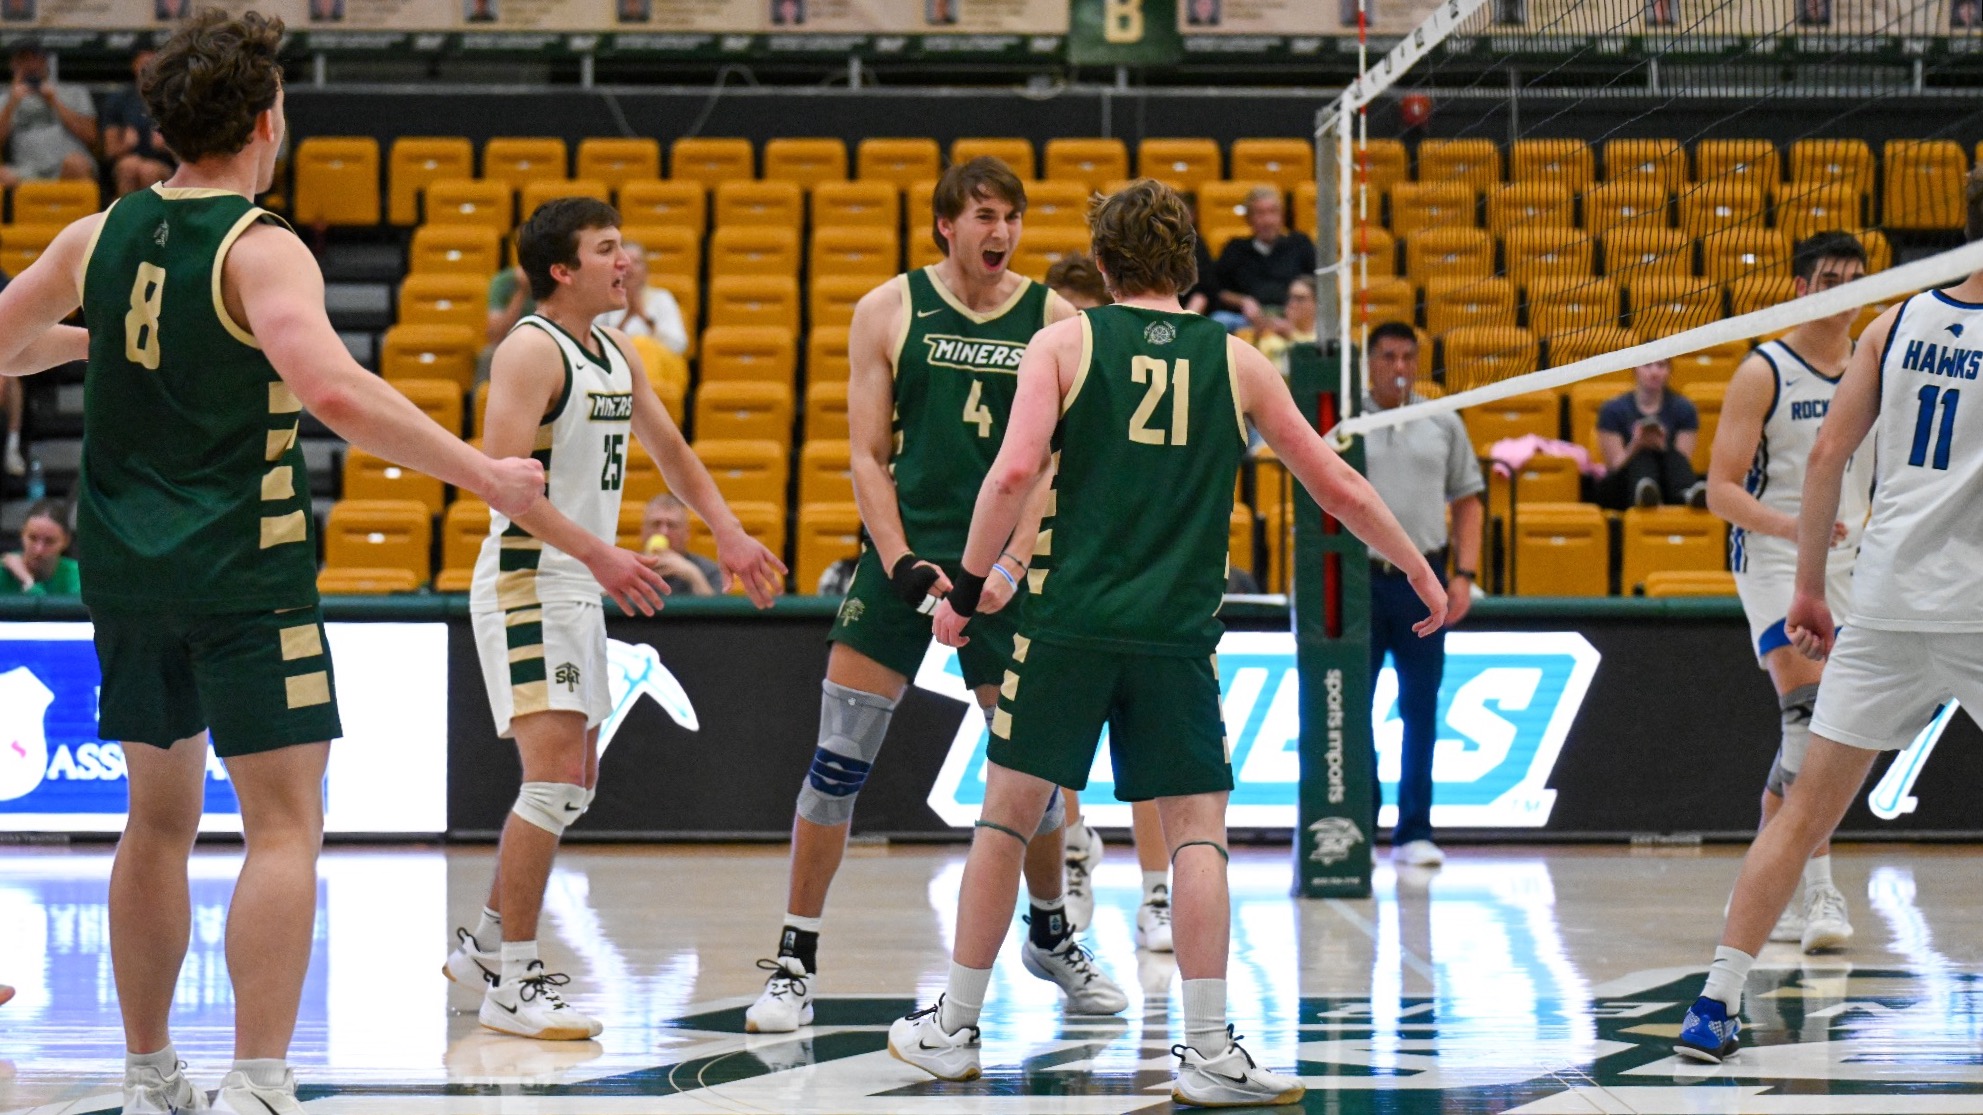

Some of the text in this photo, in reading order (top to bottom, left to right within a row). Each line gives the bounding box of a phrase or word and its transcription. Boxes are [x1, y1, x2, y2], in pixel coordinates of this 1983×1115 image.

[125, 261, 166, 370] 8
[935, 338, 1026, 367] MINERS
[1902, 340, 1983, 381] HAWKS
[963, 379, 993, 438] 4
[1129, 355, 1190, 446] 21
[1908, 384, 1960, 471] 11
[601, 434, 624, 491] 25
[1324, 668, 1346, 804] sports imports
